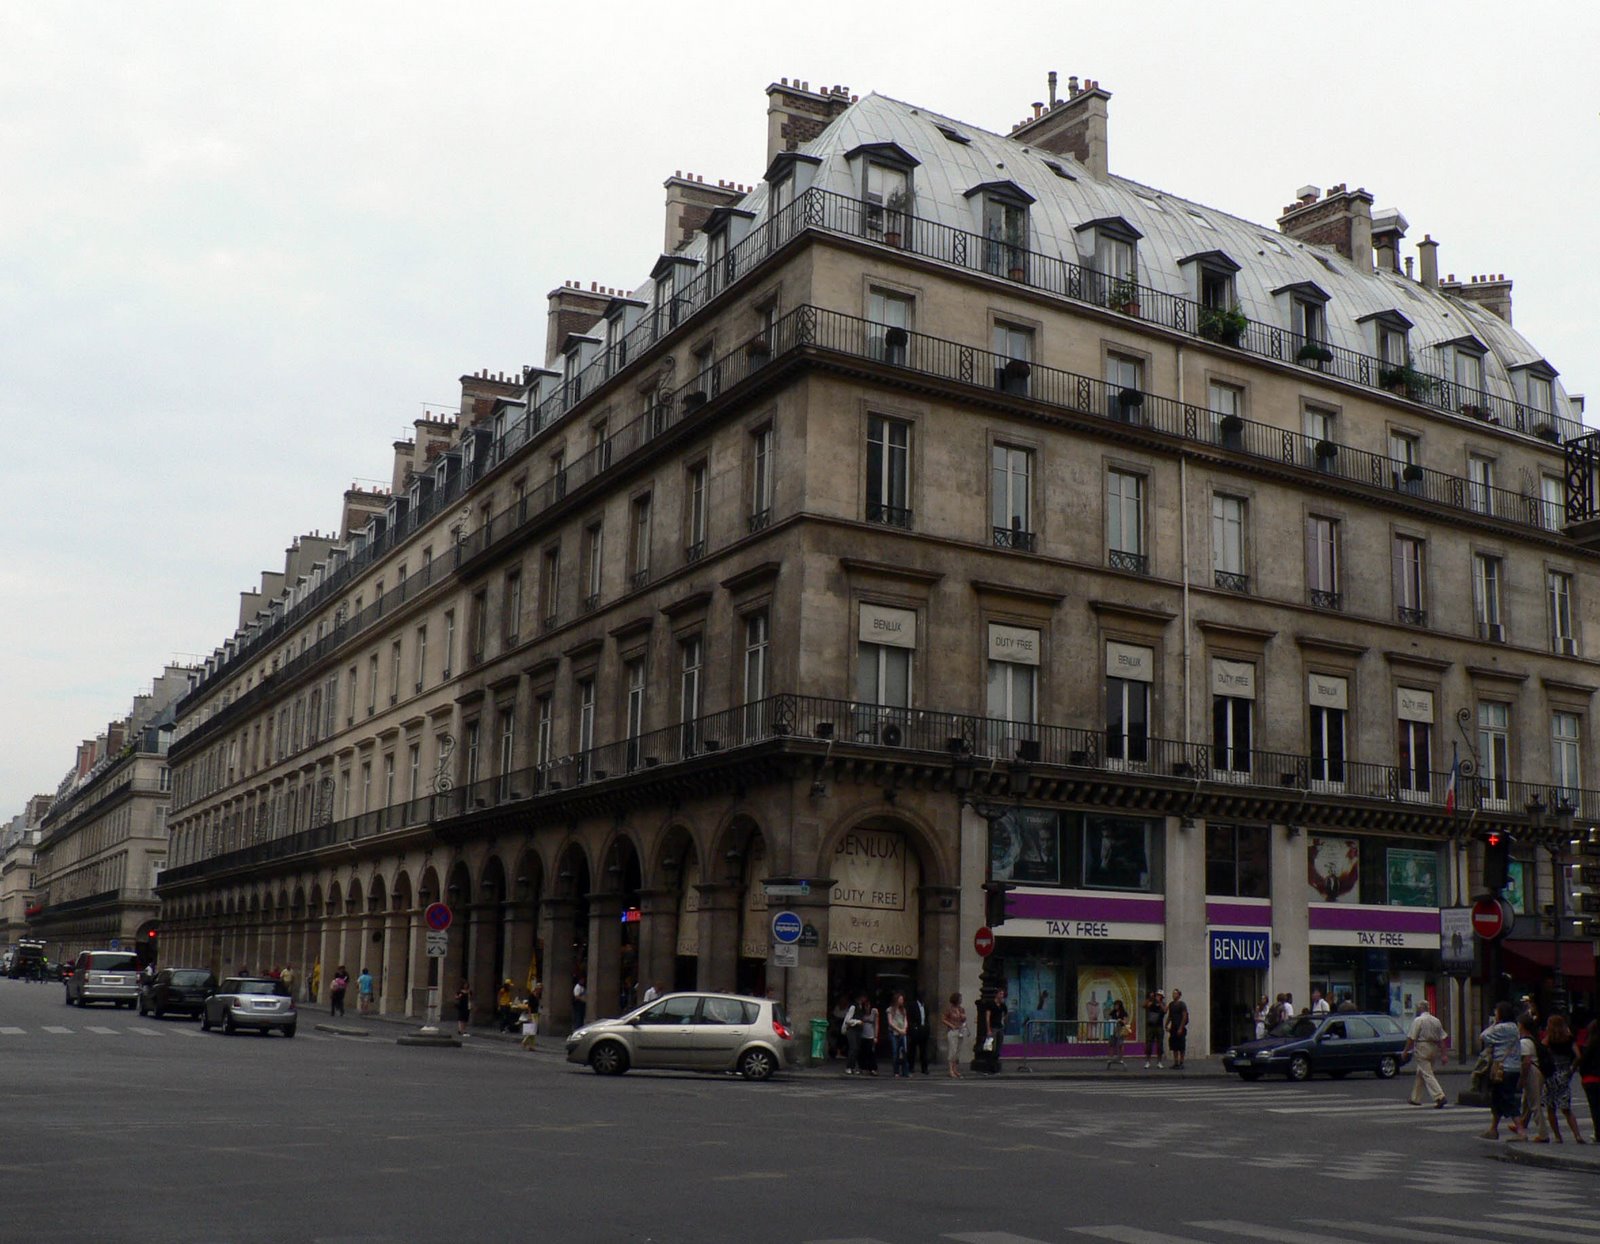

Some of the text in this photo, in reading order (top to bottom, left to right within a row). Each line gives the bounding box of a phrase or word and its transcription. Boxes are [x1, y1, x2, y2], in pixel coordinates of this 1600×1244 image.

[873, 618, 903, 633] BENLUX
[995, 636, 1033, 651] DUTY FREE
[833, 888, 898, 906] DUTY FREE
[1046, 921, 1109, 937] TAX FREE
[1357, 932, 1404, 946] TAX FREE
[870, 943, 914, 957] CAMBIO
[1214, 938, 1266, 961] BENLUX
